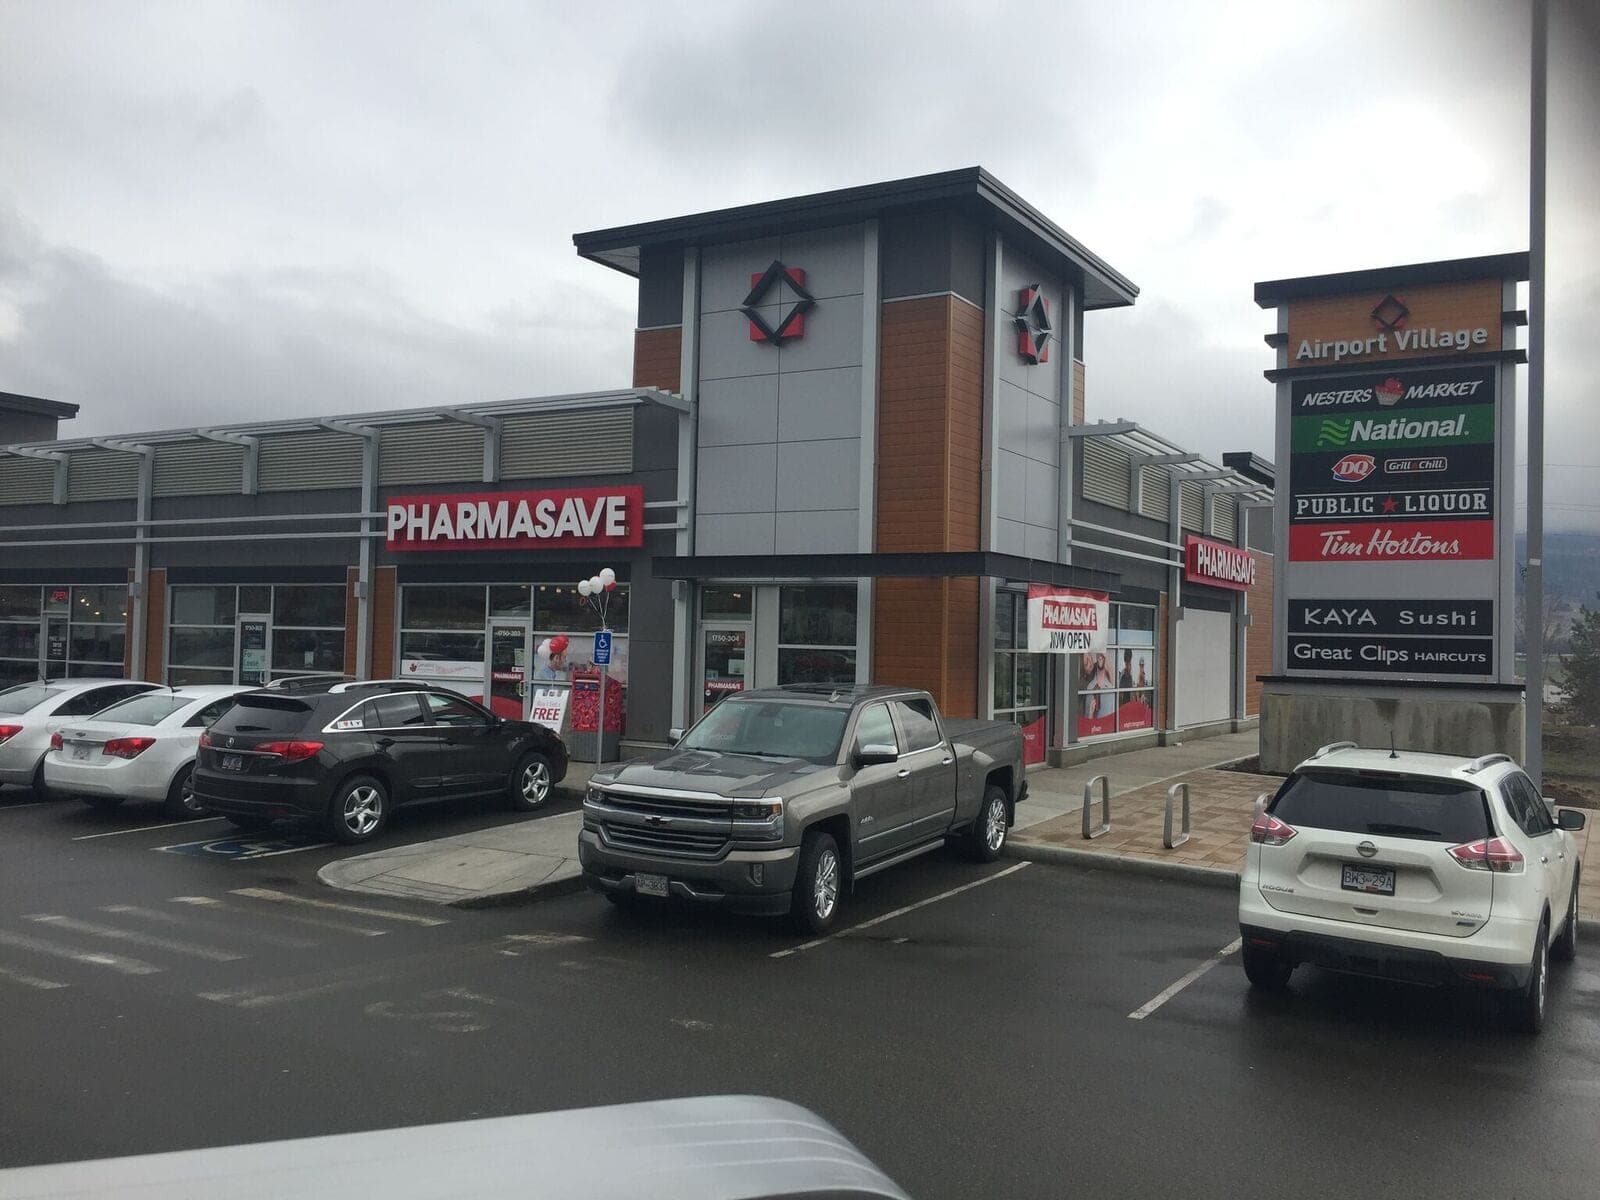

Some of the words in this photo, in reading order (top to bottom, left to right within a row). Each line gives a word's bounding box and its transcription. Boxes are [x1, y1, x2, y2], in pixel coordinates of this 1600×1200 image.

[1296, 332, 1387, 361] Airport
[1393, 327, 1489, 351] Village
[1301, 389, 1372, 407] NESTERS
[1404, 380, 1484, 400] MARKET
[1340, 460, 1370, 476] DQ
[1388, 461, 1411, 470] Grill
[1418, 459, 1445, 469] Chill
[1296, 496, 1375, 516] PUBLIC
[1404, 492, 1487, 512] LIQUOR
[387, 495, 626, 541] PHARMASAVE
[1320, 530, 1362, 557] Tim
[1366, 528, 1462, 556] Hortons
[1197, 543, 1256, 586] PHARMASAVE
[1043, 604, 1097, 627] PHARMASAVE
[1304, 607, 1378, 627] KAYA
[1399, 609, 1477, 627] Sushi
[1067, 631, 1091, 649] OPEN
[1293, 643, 1353, 661] Great
[1360, 645, 1409, 666] Clips
[1414, 652, 1487, 664] HAIRCUTS
[708, 682, 741, 690] PHARMASAVE
[533, 707, 561, 721] FREE
